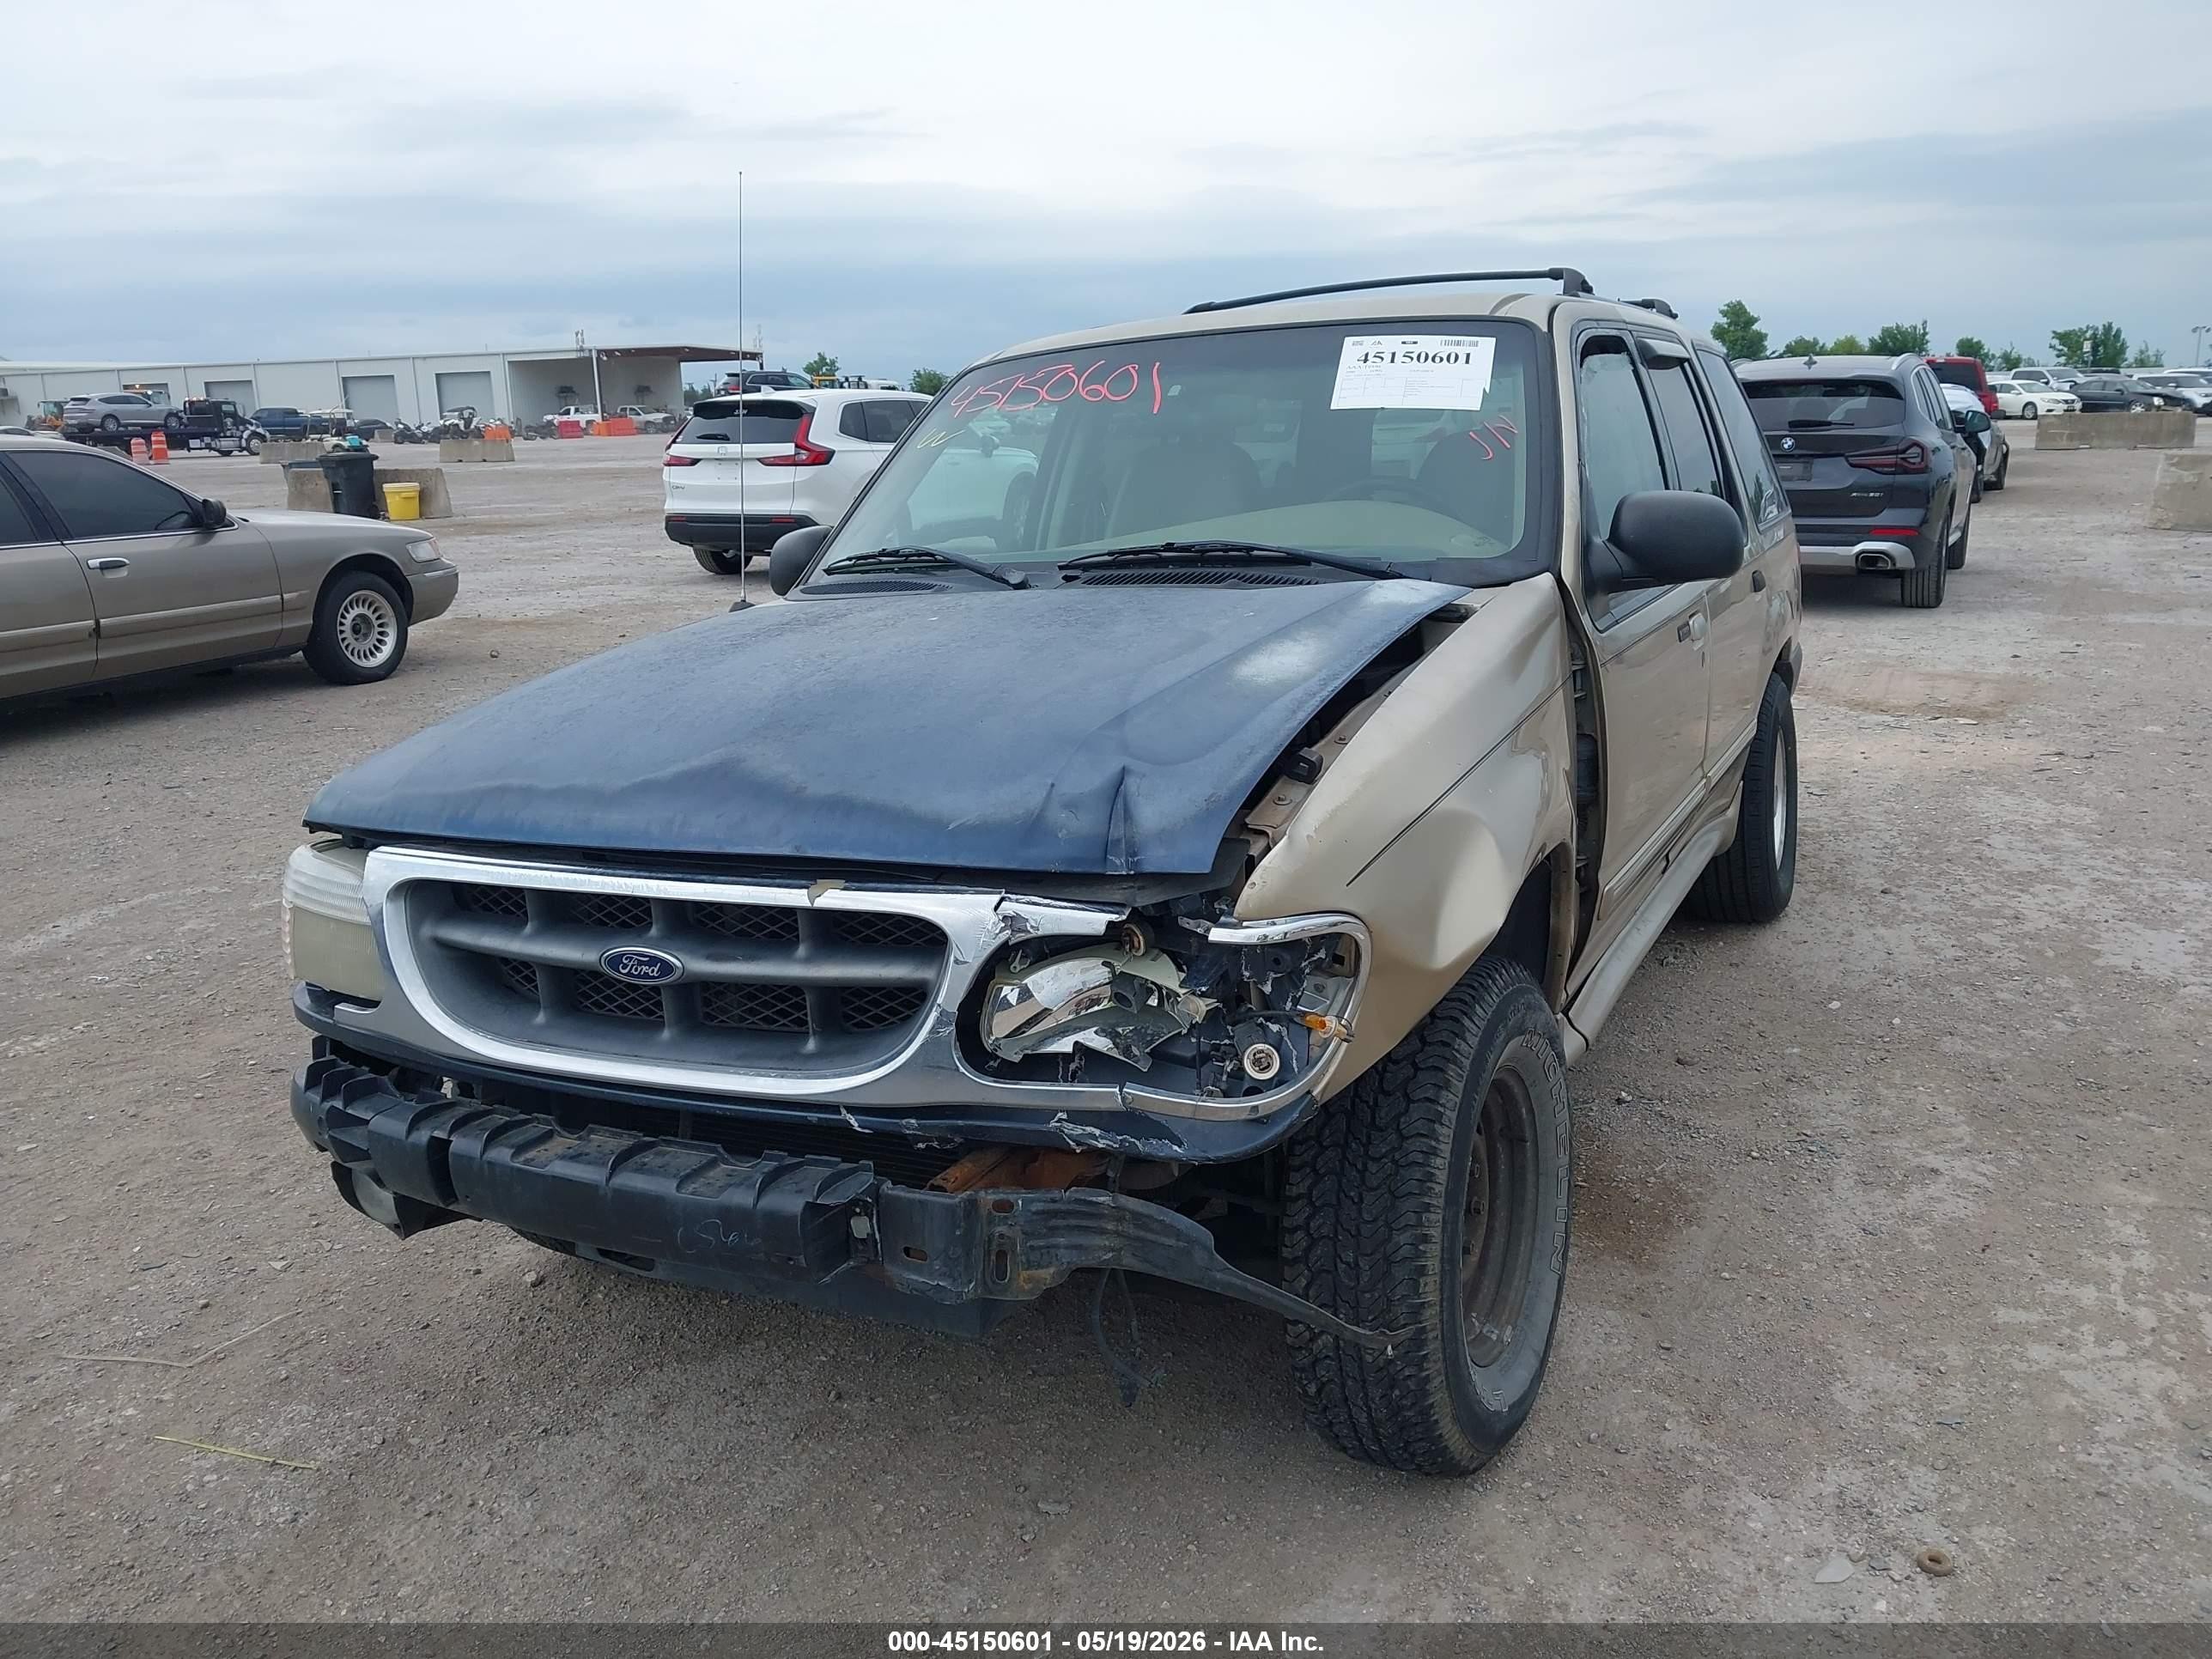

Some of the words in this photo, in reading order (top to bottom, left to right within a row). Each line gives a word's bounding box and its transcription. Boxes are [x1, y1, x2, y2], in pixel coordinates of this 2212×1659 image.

[1357, 350, 1472, 365] 45150601
[951, 360, 1162, 419] 45150601
[618, 954, 661, 977] Ford
[1520, 1025, 1571, 1275] MICHELIN
